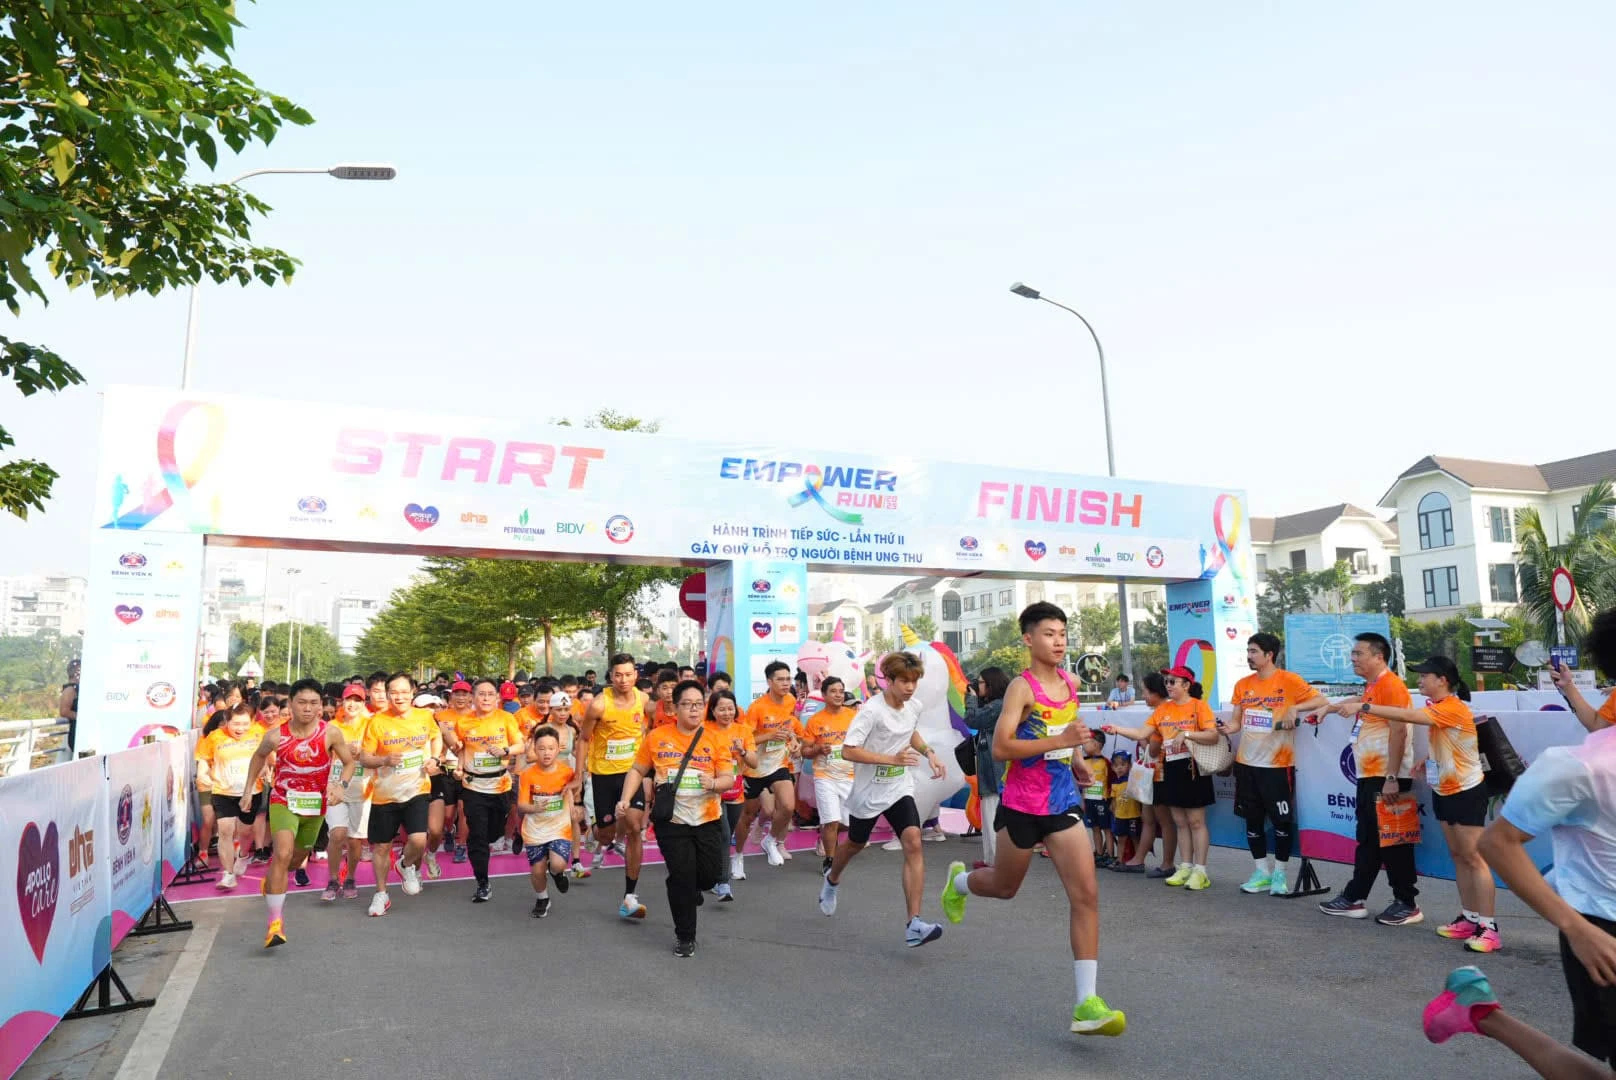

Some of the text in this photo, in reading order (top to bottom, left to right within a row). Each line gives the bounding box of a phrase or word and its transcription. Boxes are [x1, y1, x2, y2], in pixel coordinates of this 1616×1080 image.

[331, 427, 605, 490] START
[720, 457, 898, 491] EMPOWER
[837, 491, 883, 509] RUN
[977, 481, 1143, 528] FINISH
[556, 522, 585, 535] BIDV
[713, 523, 749, 537] HÀNH
[753, 525, 787, 539] TRÌNH
[791, 526, 814, 540] TIẾP
[817, 528, 840, 542] SỨC
[874, 532, 895, 545] THỨ
[898, 535, 905, 545] II
[691, 541, 719, 554] GÂY
[722, 543, 749, 556] QUỸ
[801, 547, 840, 560] NGƯỜI
[844, 547, 872, 564] BỆNH
[876, 551, 900, 562] UNG
[1117, 552, 1134, 561] BIDV
[1168, 600, 1210, 612] EMPOWER
[1276, 800, 1290, 816] 10
[25, 861, 52, 897] APOLLO
